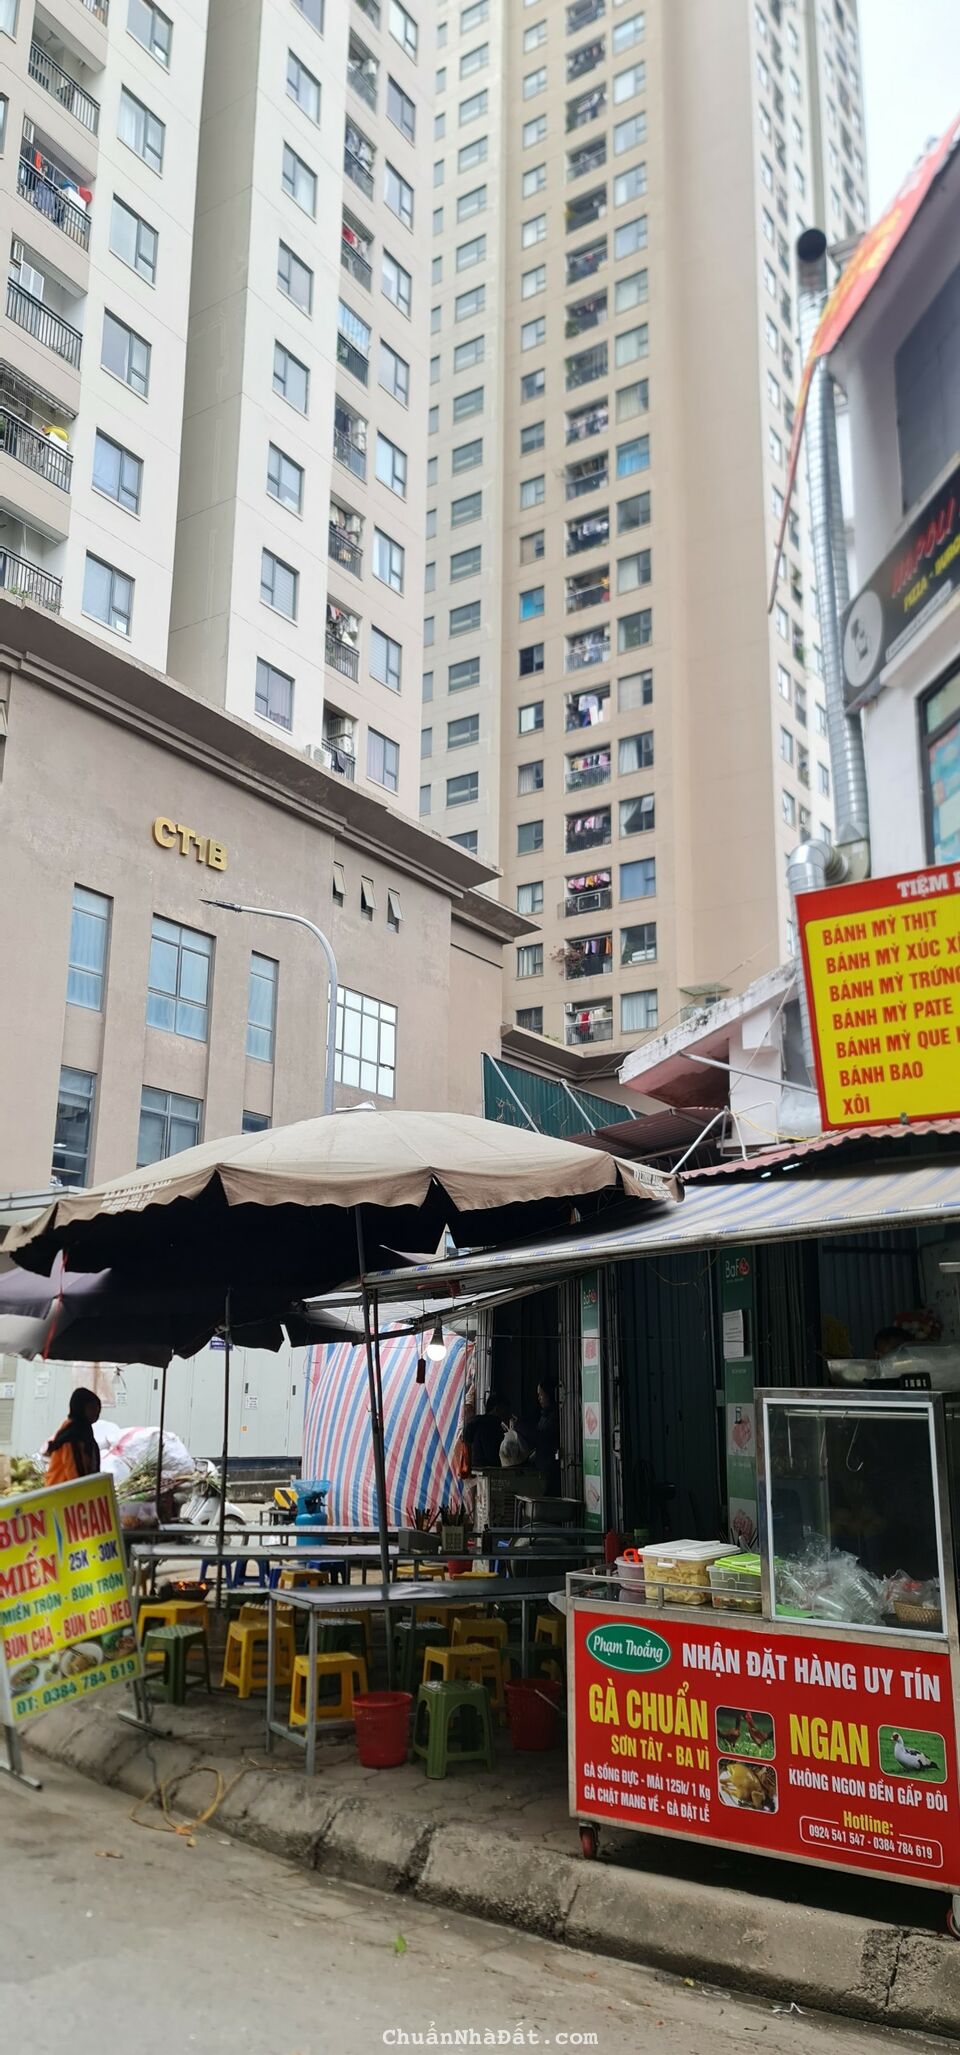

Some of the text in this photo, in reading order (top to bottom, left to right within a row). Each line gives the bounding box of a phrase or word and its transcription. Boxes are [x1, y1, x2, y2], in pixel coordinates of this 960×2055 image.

[152, 816, 228, 872] CT1B
[897, 873, 949, 898] TIỆM
[822, 924, 867, 946] BÁNH
[901, 909, 937, 933] THỊT
[826, 952, 871, 975] BÁNH
[906, 937, 940, 961] XÚC
[829, 979, 874, 1003] BÁNH
[832, 1008, 878, 1030] BÁNH
[913, 996, 954, 1019] PATE
[836, 1036, 881, 1059] BÁNH
[917, 1027, 951, 1050] QUE
[839, 1060, 924, 1087] BÁNH BAO
[842, 1093, 870, 1115] XÔI
[63, 1496, 113, 1544] NGAN
[0, 1545, 59, 1599] MIẾN
[68, 1550, 90, 1572] 25K
[98, 1540, 119, 1562] 30K
[96, 1573, 124, 1593] TRỘN
[110, 1599, 132, 1623] HEO
[593, 1635, 663, 1663] Phạm Thoắng
[43, 1681, 77, 1704] 0384
[81, 1671, 106, 1689] 784
[110, 1659, 135, 1679] 619
[682, 1641, 941, 1703] NHẬN ĐẶT HÀNG UY TÍN
[588, 1678, 709, 1740] GÀ CHUẨN
[611, 1734, 637, 1758] SƠN
[640, 1737, 663, 1762] TÂY
[675, 1745, 694, 1768] BA
[697, 1746, 710, 1771] VÌ
[789, 1713, 870, 1767] NGAN
[583, 1760, 596, 1778] GÀ
[597, 1762, 620, 1783] SỐNG
[621, 1769, 639, 1788] ĐỰC
[699, 1783, 711, 1802] Kg
[788, 1767, 949, 1812] KHÔNG NGON ĐỀN GẤP ĐÔI
[584, 1783, 596, 1801] GÀ
[597, 1787, 619, 1807] CHẶT
[620, 1792, 647, 1811] MANG
[666, 1798, 680, 1817] GÀ
[681, 1803, 698, 1822] ĐẶT
[843, 1810, 894, 1836] Hotline:
[808, 1824, 830, 1840] 0924
[831, 1828, 847, 1843] 541
[849, 1832, 865, 1846] 547
[873, 1836, 895, 1853] 0384
[897, 1841, 913, 1856] 784
[915, 1845, 933, 1860] 619
